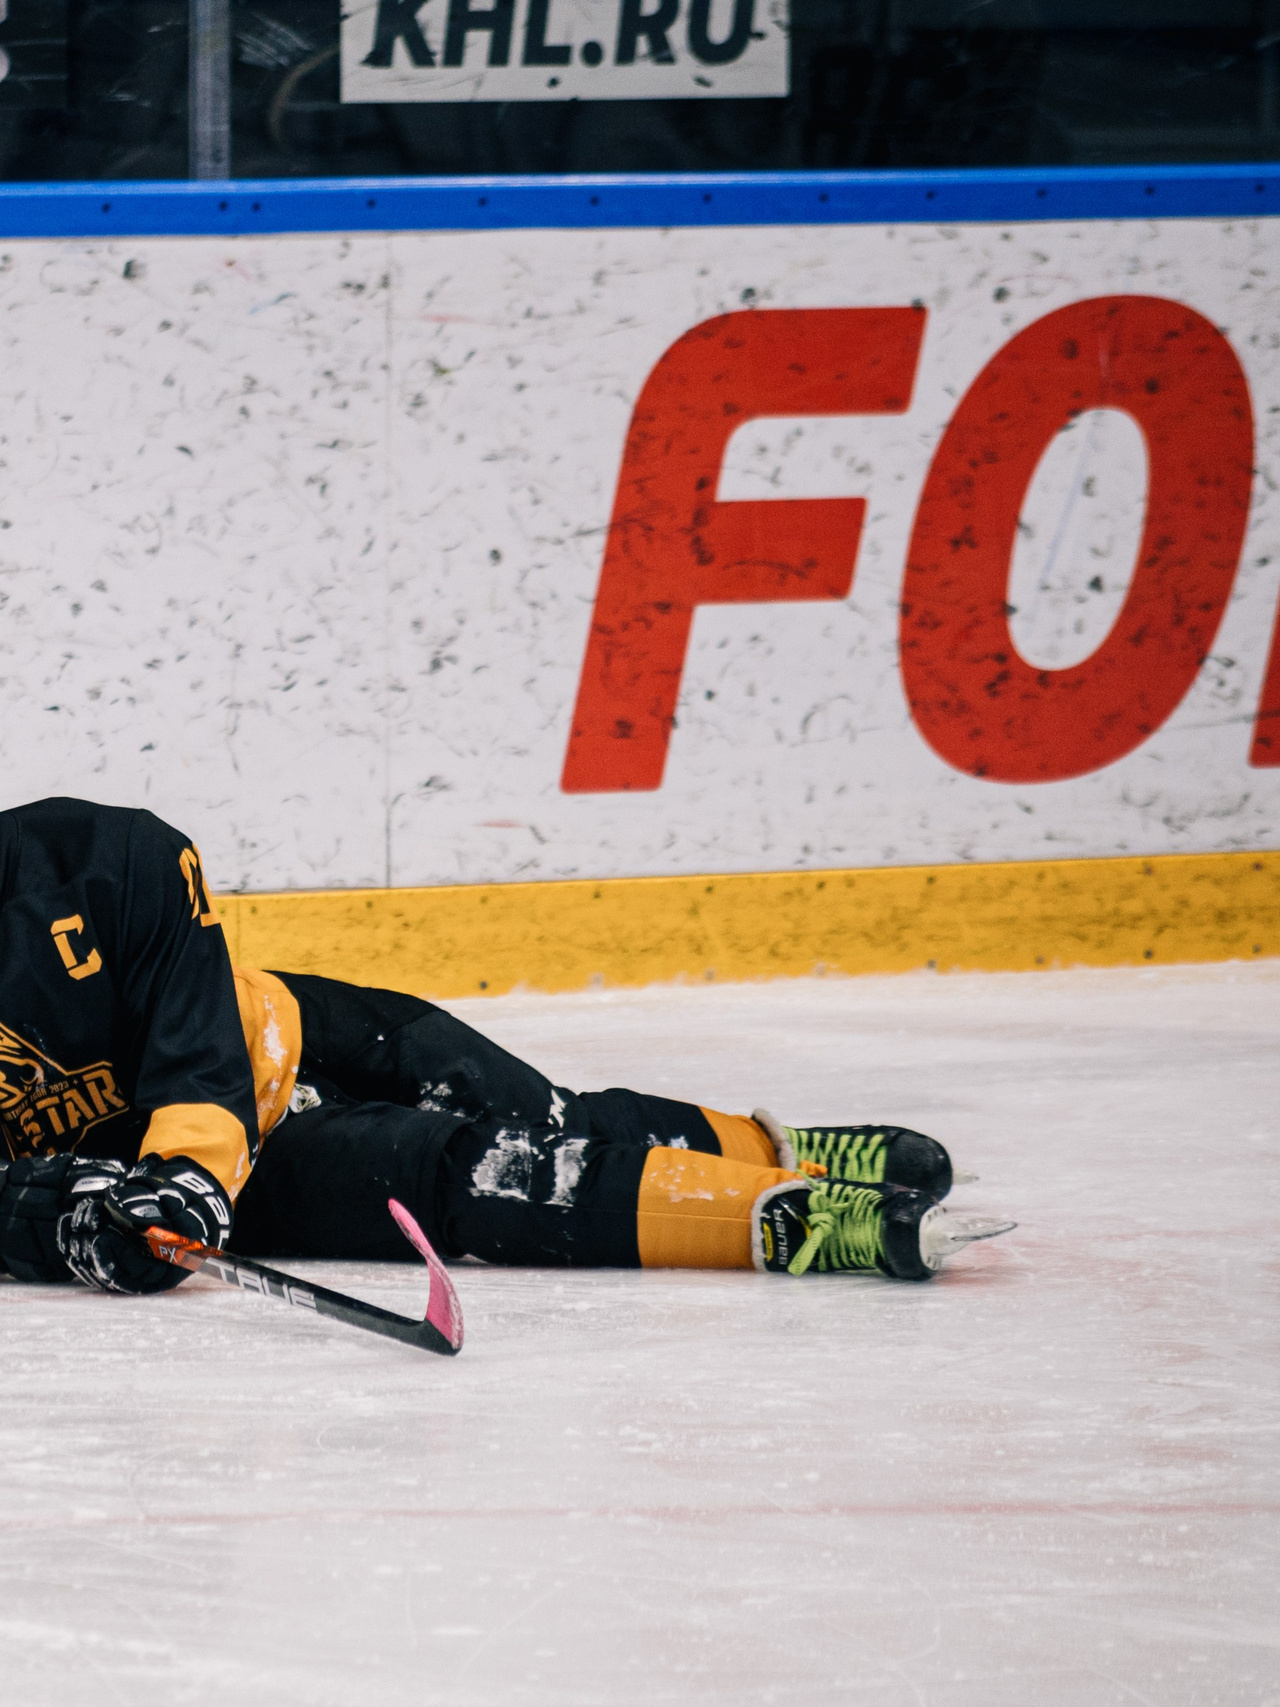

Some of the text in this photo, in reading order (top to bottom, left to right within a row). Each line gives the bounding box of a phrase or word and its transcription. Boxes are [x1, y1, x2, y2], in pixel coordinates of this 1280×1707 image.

[363, 0, 755, 69] KHL.RU
[559, 294, 1280, 794] FO
[50, 914, 102, 981] C
